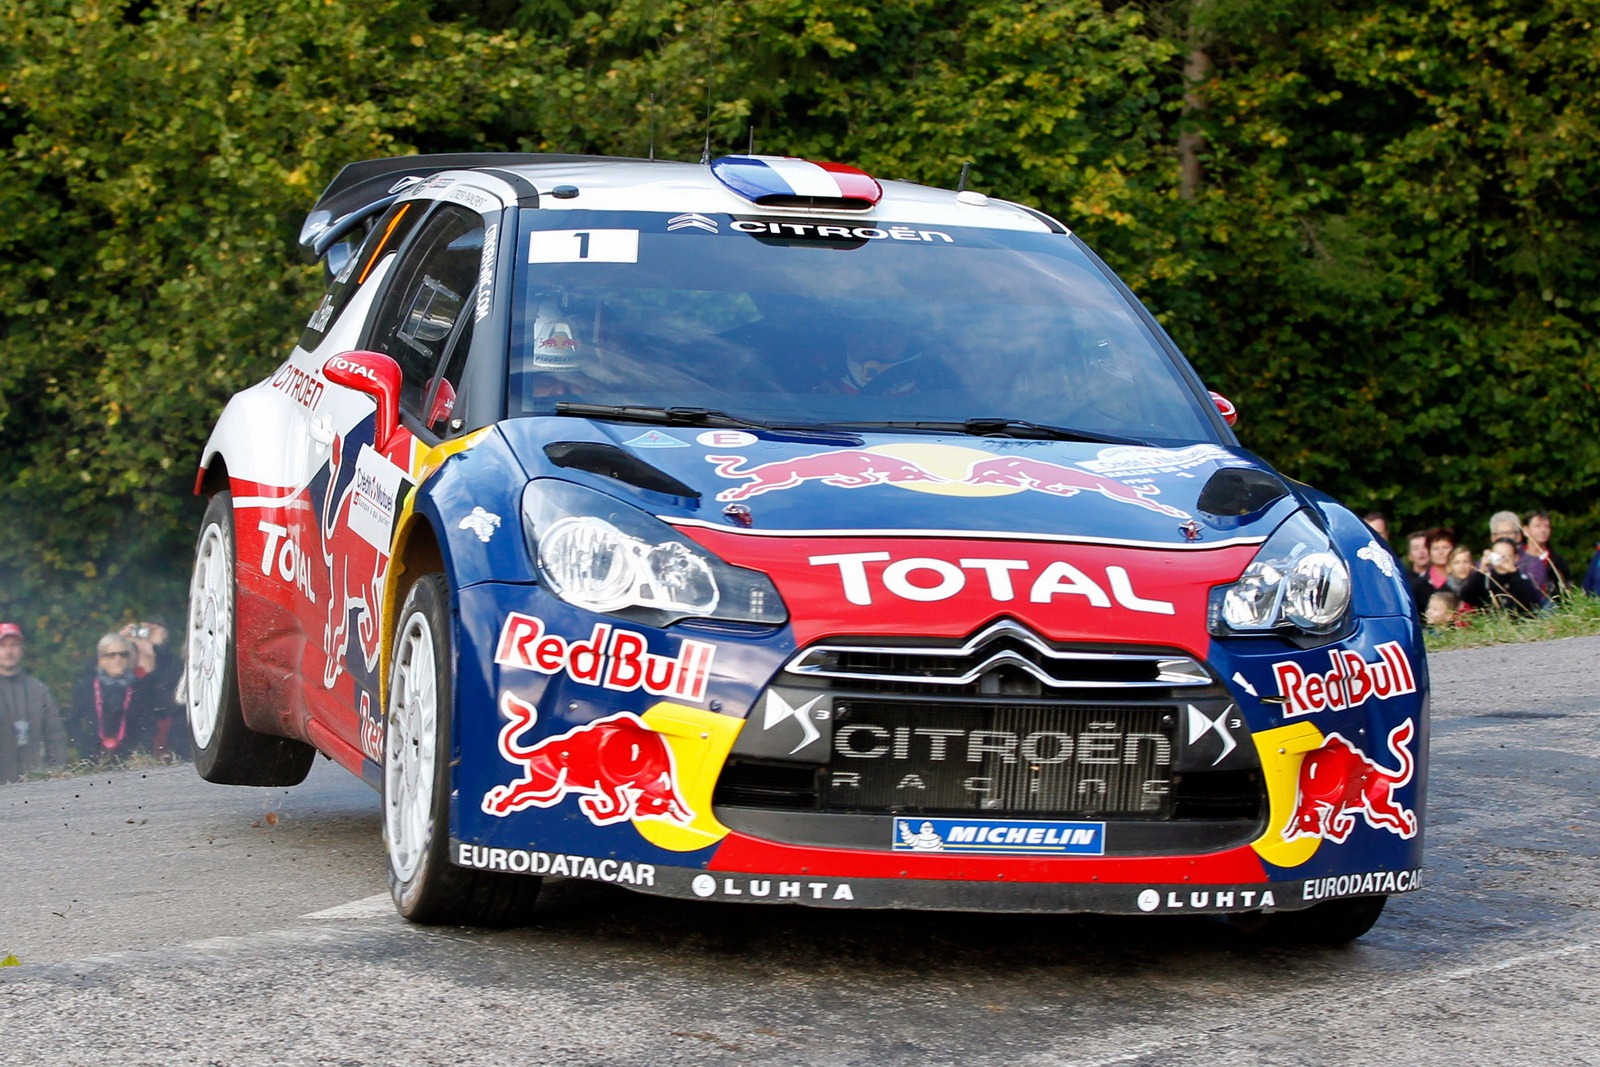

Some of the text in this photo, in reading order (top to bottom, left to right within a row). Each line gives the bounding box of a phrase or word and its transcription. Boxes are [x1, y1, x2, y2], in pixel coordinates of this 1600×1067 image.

[730, 220, 954, 243] CITROËN
[573, 232, 590, 259] 1
[331, 357, 378, 381] TOTAL
[713, 433, 742, 445] E
[1103, 468, 1160, 478] RALLYE
[1160, 465, 1181, 474] DE
[258, 520, 316, 604] TOTAL
[808, 551, 1176, 615] TOTAL
[498, 613, 714, 700] Red Bull
[1274, 642, 1415, 717] Red Bull
[833, 721, 1172, 765] CITROËN
[831, 771, 1171, 795] RACING
[946, 826, 1097, 845] MICHELIN
[458, 843, 656, 887] EURODATACAR
[723, 878, 855, 900] LUHTA
[1166, 890, 1276, 908] LUHTA
